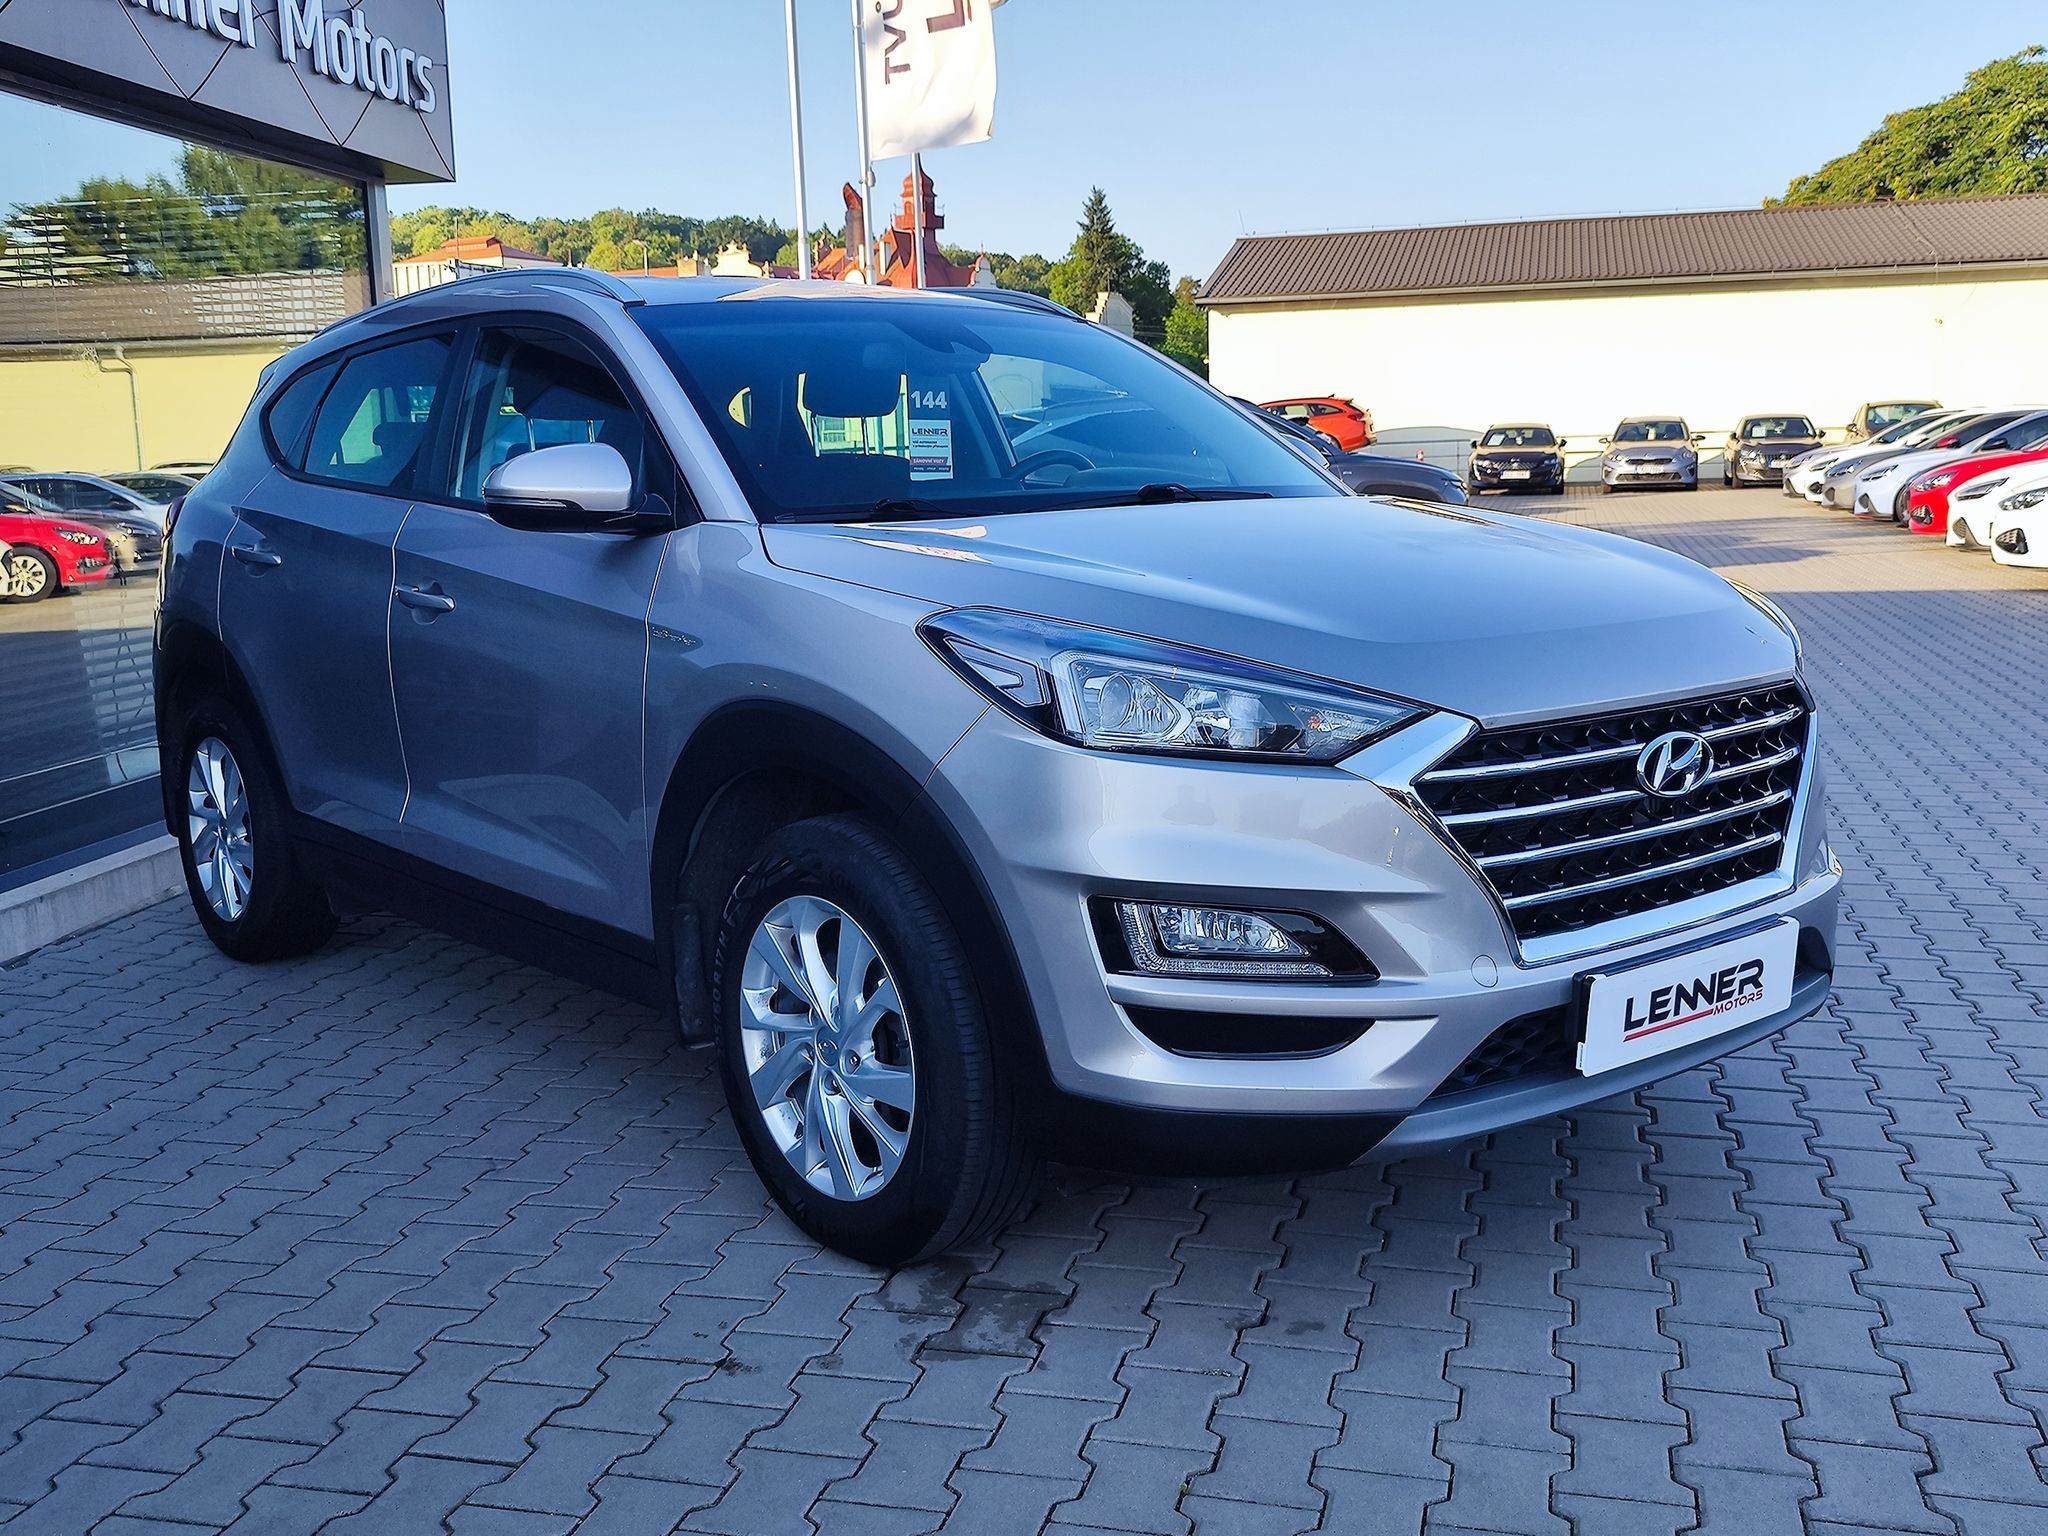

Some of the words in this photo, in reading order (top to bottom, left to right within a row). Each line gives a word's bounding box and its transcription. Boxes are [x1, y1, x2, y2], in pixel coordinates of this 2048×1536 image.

[277, 0, 437, 114] Motors
[911, 390, 947, 409] 144
[911, 428, 948, 437] LENNER
[1623, 958, 1765, 1033] LENNER
[1712, 988, 1764, 1016] MOTORS
